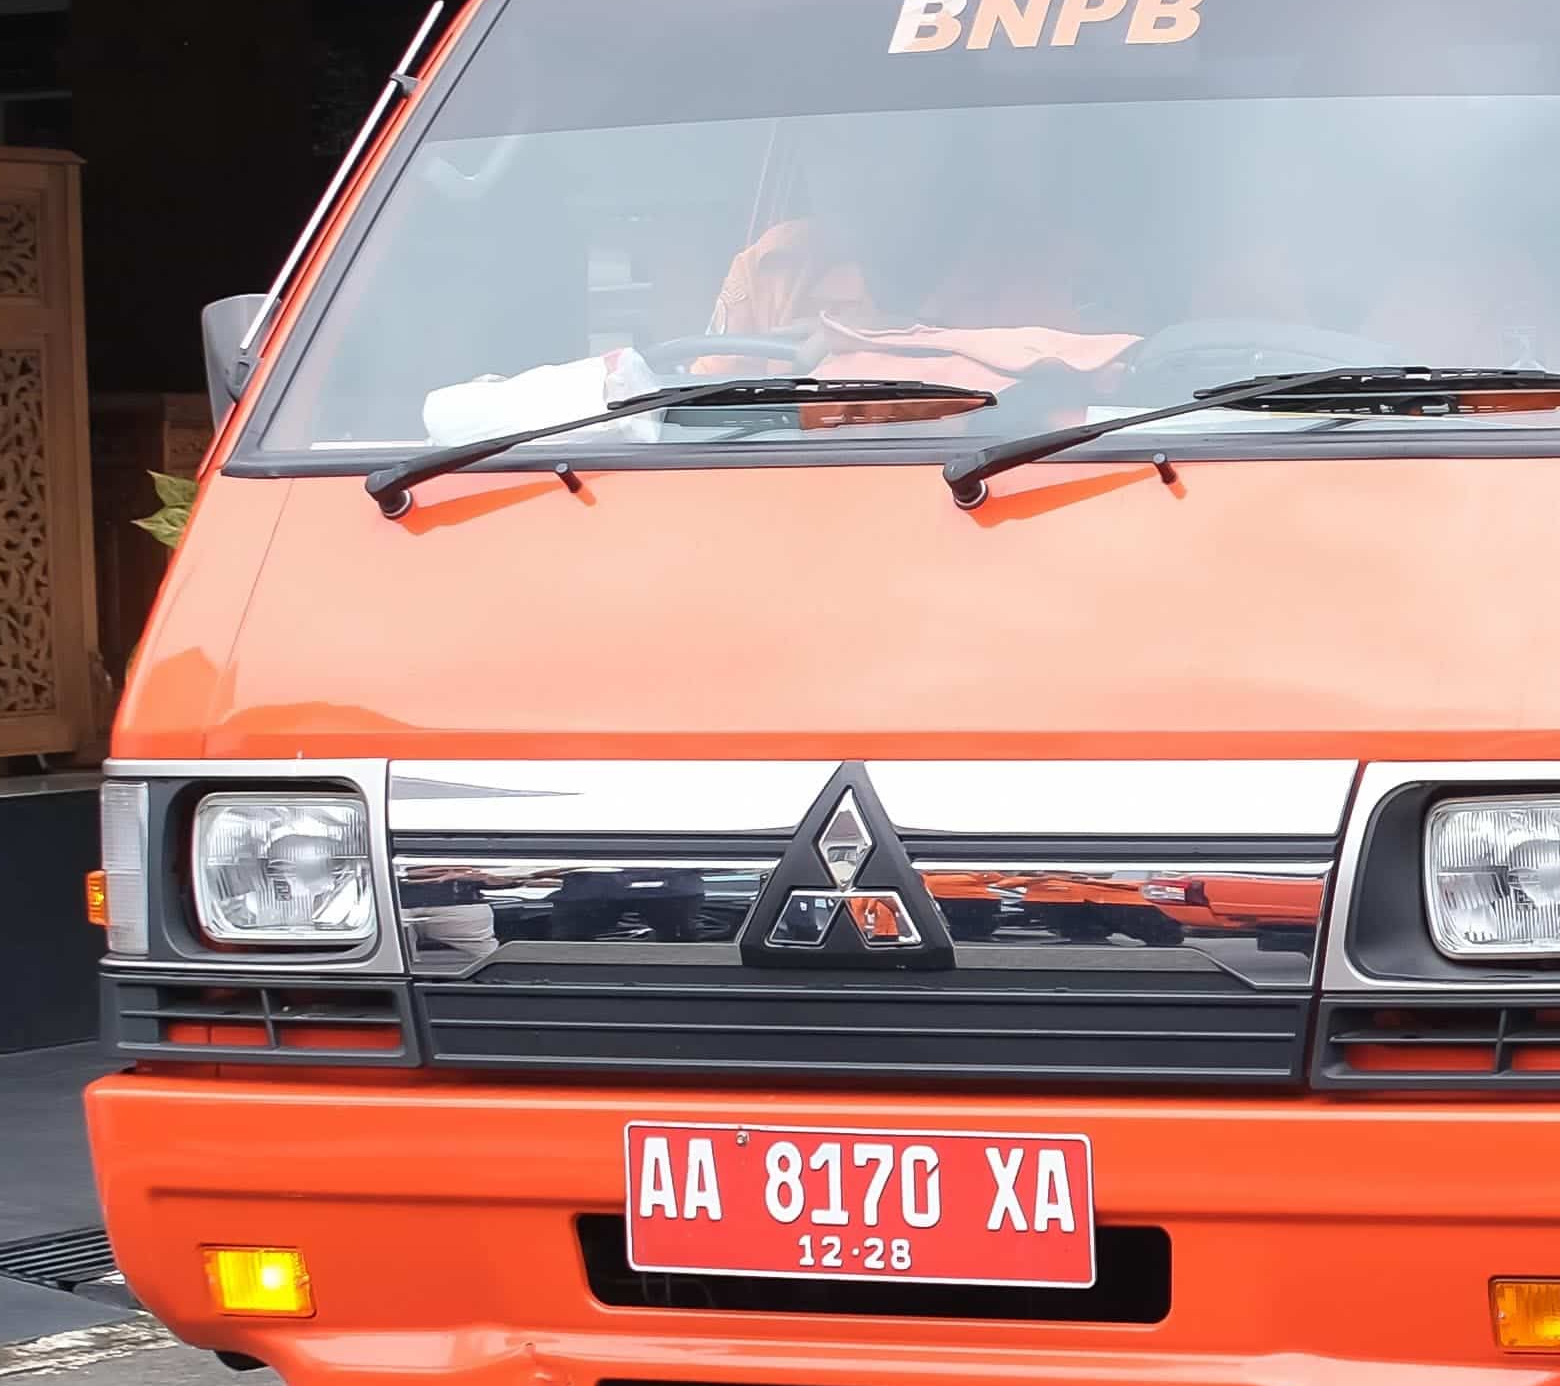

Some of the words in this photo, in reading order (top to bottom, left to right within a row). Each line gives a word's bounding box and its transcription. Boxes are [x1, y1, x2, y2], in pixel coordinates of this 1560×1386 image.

[639, 1136, 723, 1221] AA
[764, 1141, 940, 1228] 8170
[984, 1147, 1075, 1232] XA
